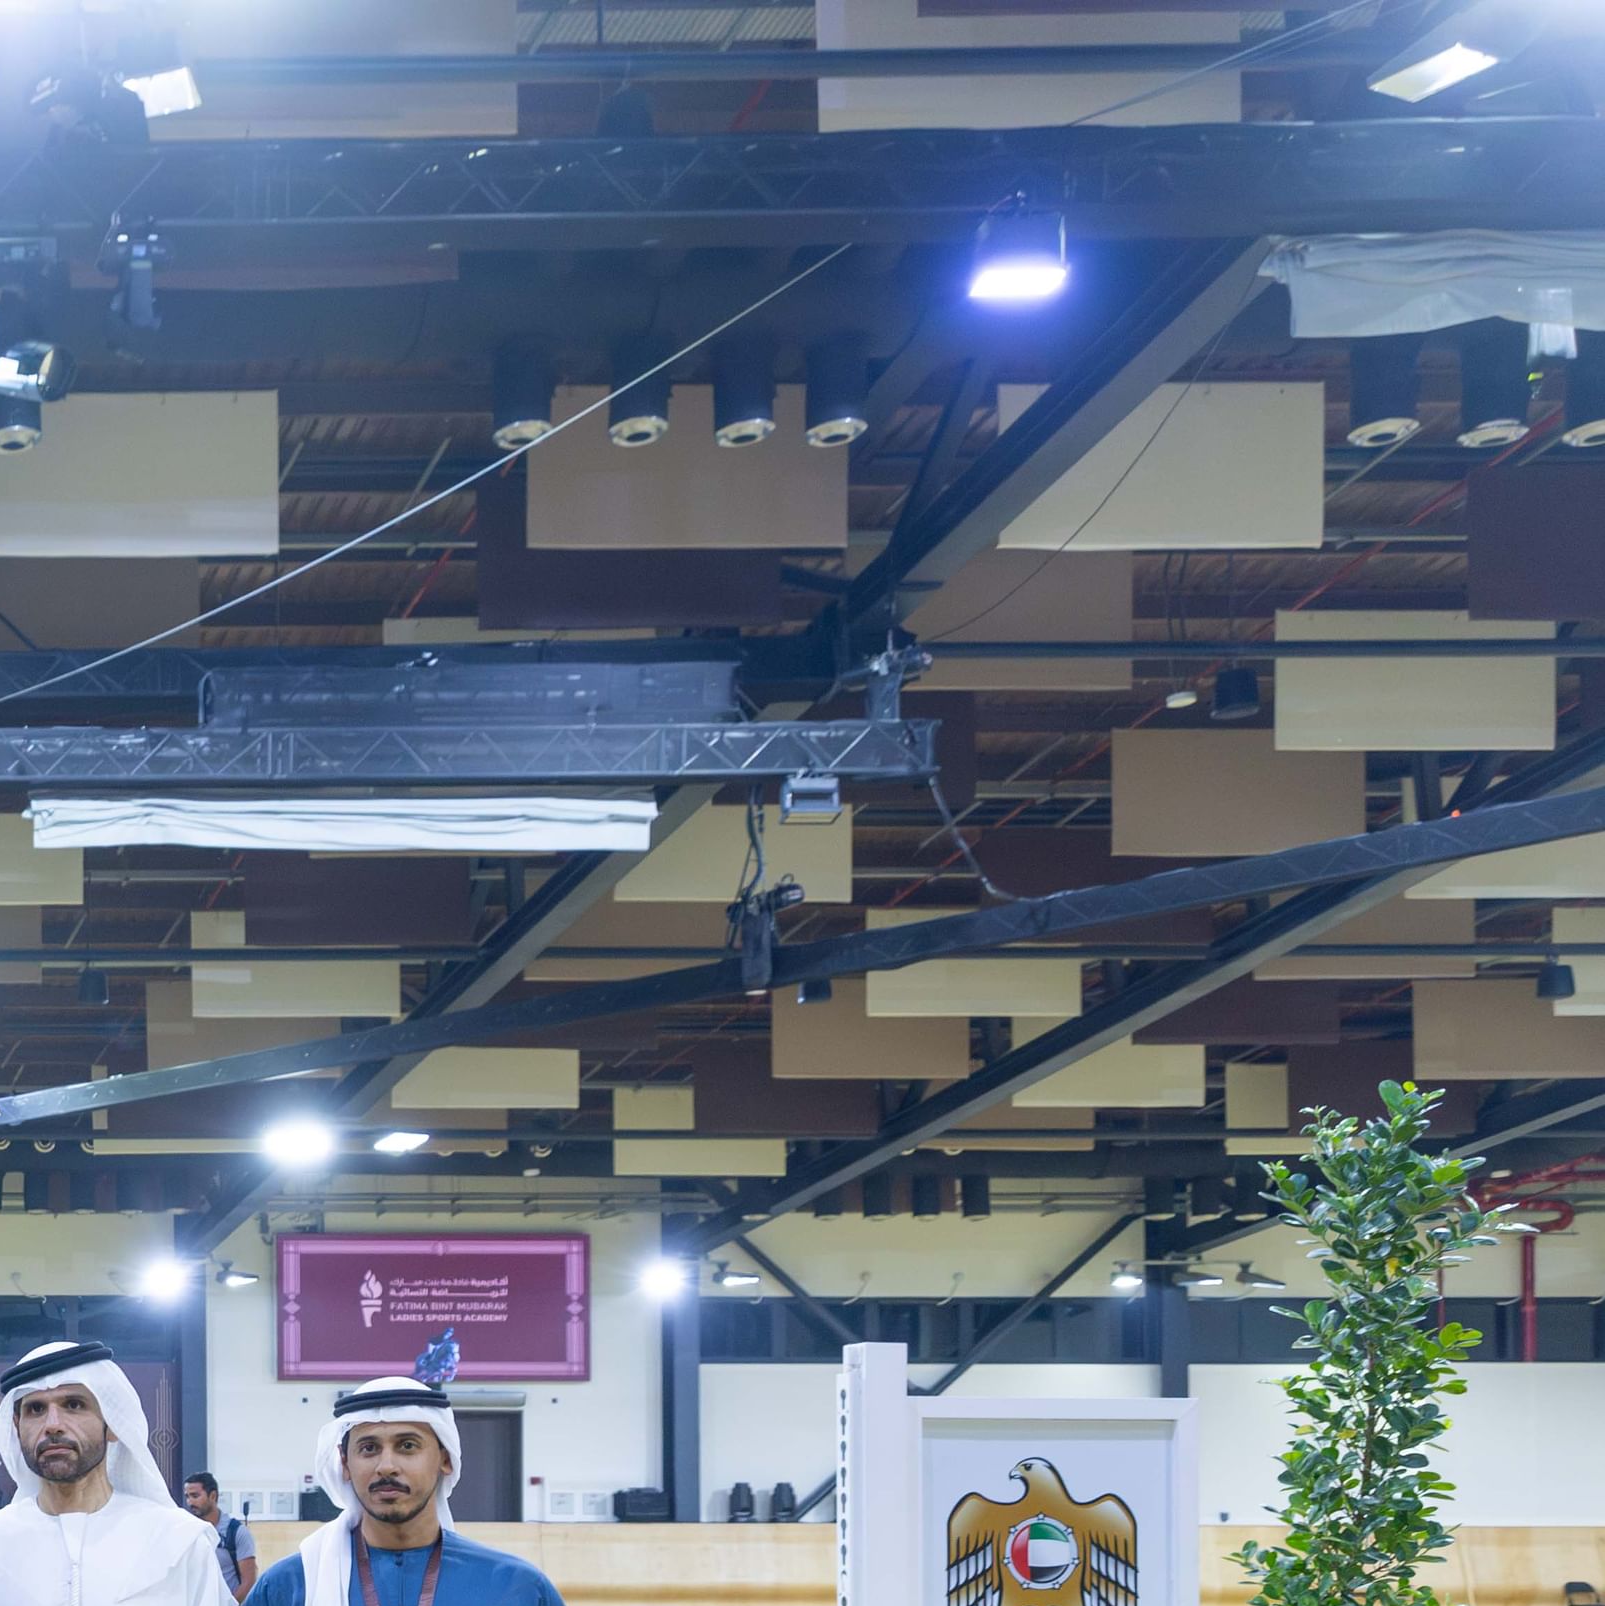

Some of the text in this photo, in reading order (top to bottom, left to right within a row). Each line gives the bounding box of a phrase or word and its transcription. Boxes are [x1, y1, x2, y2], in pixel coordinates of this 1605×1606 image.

[390, 1302, 508, 1311] FATIMA BINT MUBARAK
[390, 1314, 508, 1322] LADIES SPORTS ACADEMY
